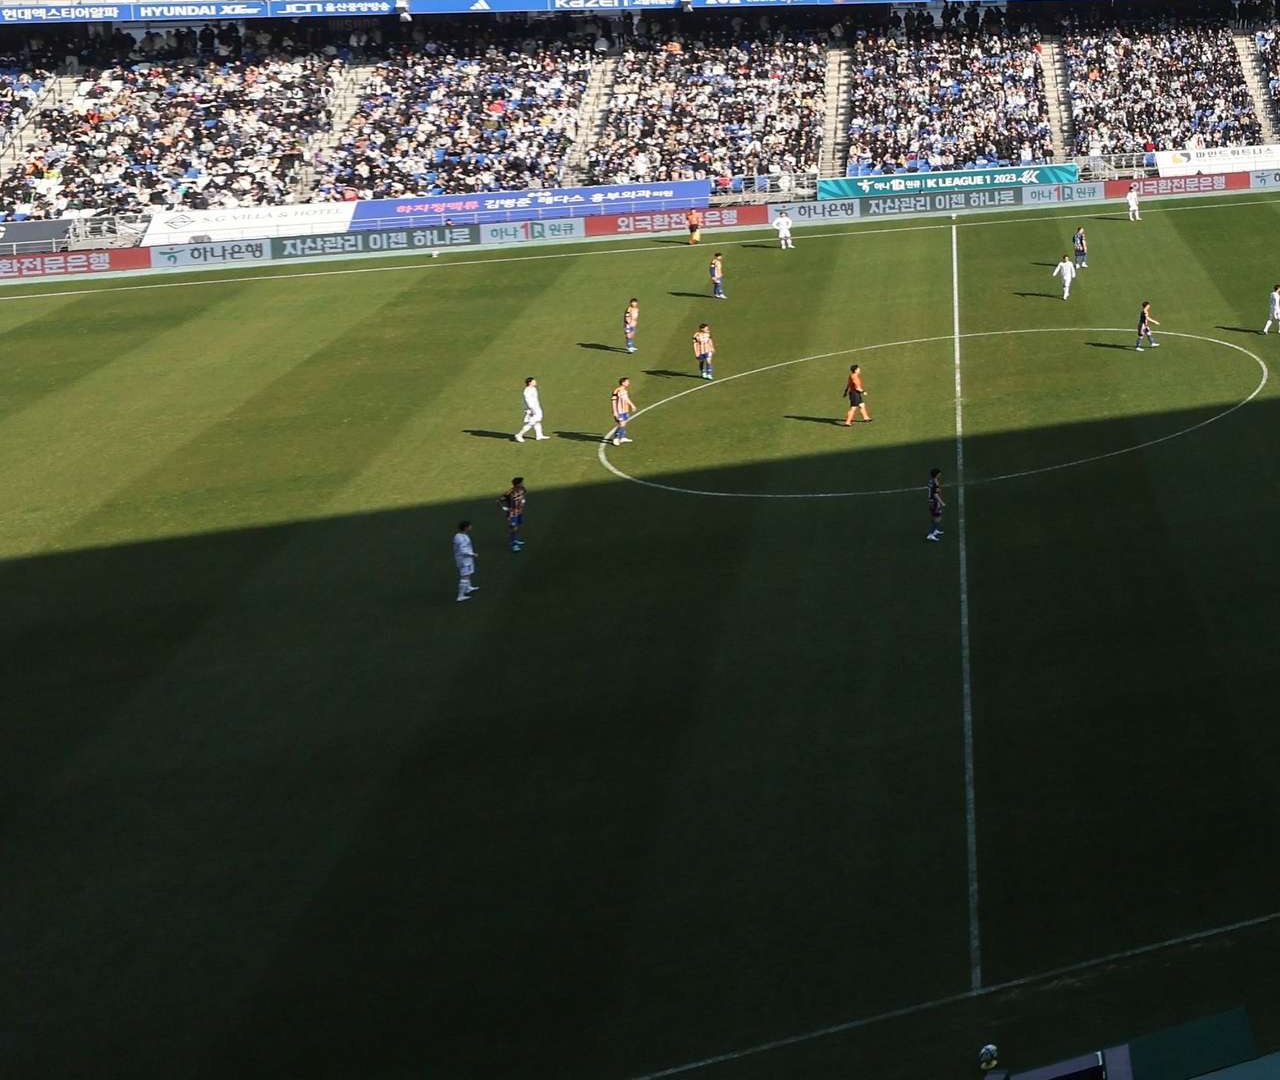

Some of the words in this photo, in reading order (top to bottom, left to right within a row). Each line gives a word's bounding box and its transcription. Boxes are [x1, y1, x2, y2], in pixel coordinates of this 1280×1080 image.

[140, 6, 217, 17] HYUNDAI
[926, 177, 938, 188] K
[939, 174, 984, 187] LEAGUE
[994, 173, 1017, 184] 2023
[1131, 174, 1226, 195] 외국환전문은행
[868, 195, 931, 215] 자산관리
[934, 192, 966, 209] 이젠
[969, 189, 1015, 207] 하나로
[1030, 188, 1052, 202] 하나
[1052, 184, 1074, 202] 1Q
[1075, 185, 1097, 199] 원큐
[798, 201, 855, 219] 하나은행
[490, 225, 518, 241] 하나
[520, 220, 546, 240] 1Q
[548, 222, 576, 237] 원큐
[283, 234, 364, 257] 자산관리
[370, 230, 410, 251] 이젠
[413, 226, 471, 248] 하나로
[189, 242, 264, 263] 하나은행
